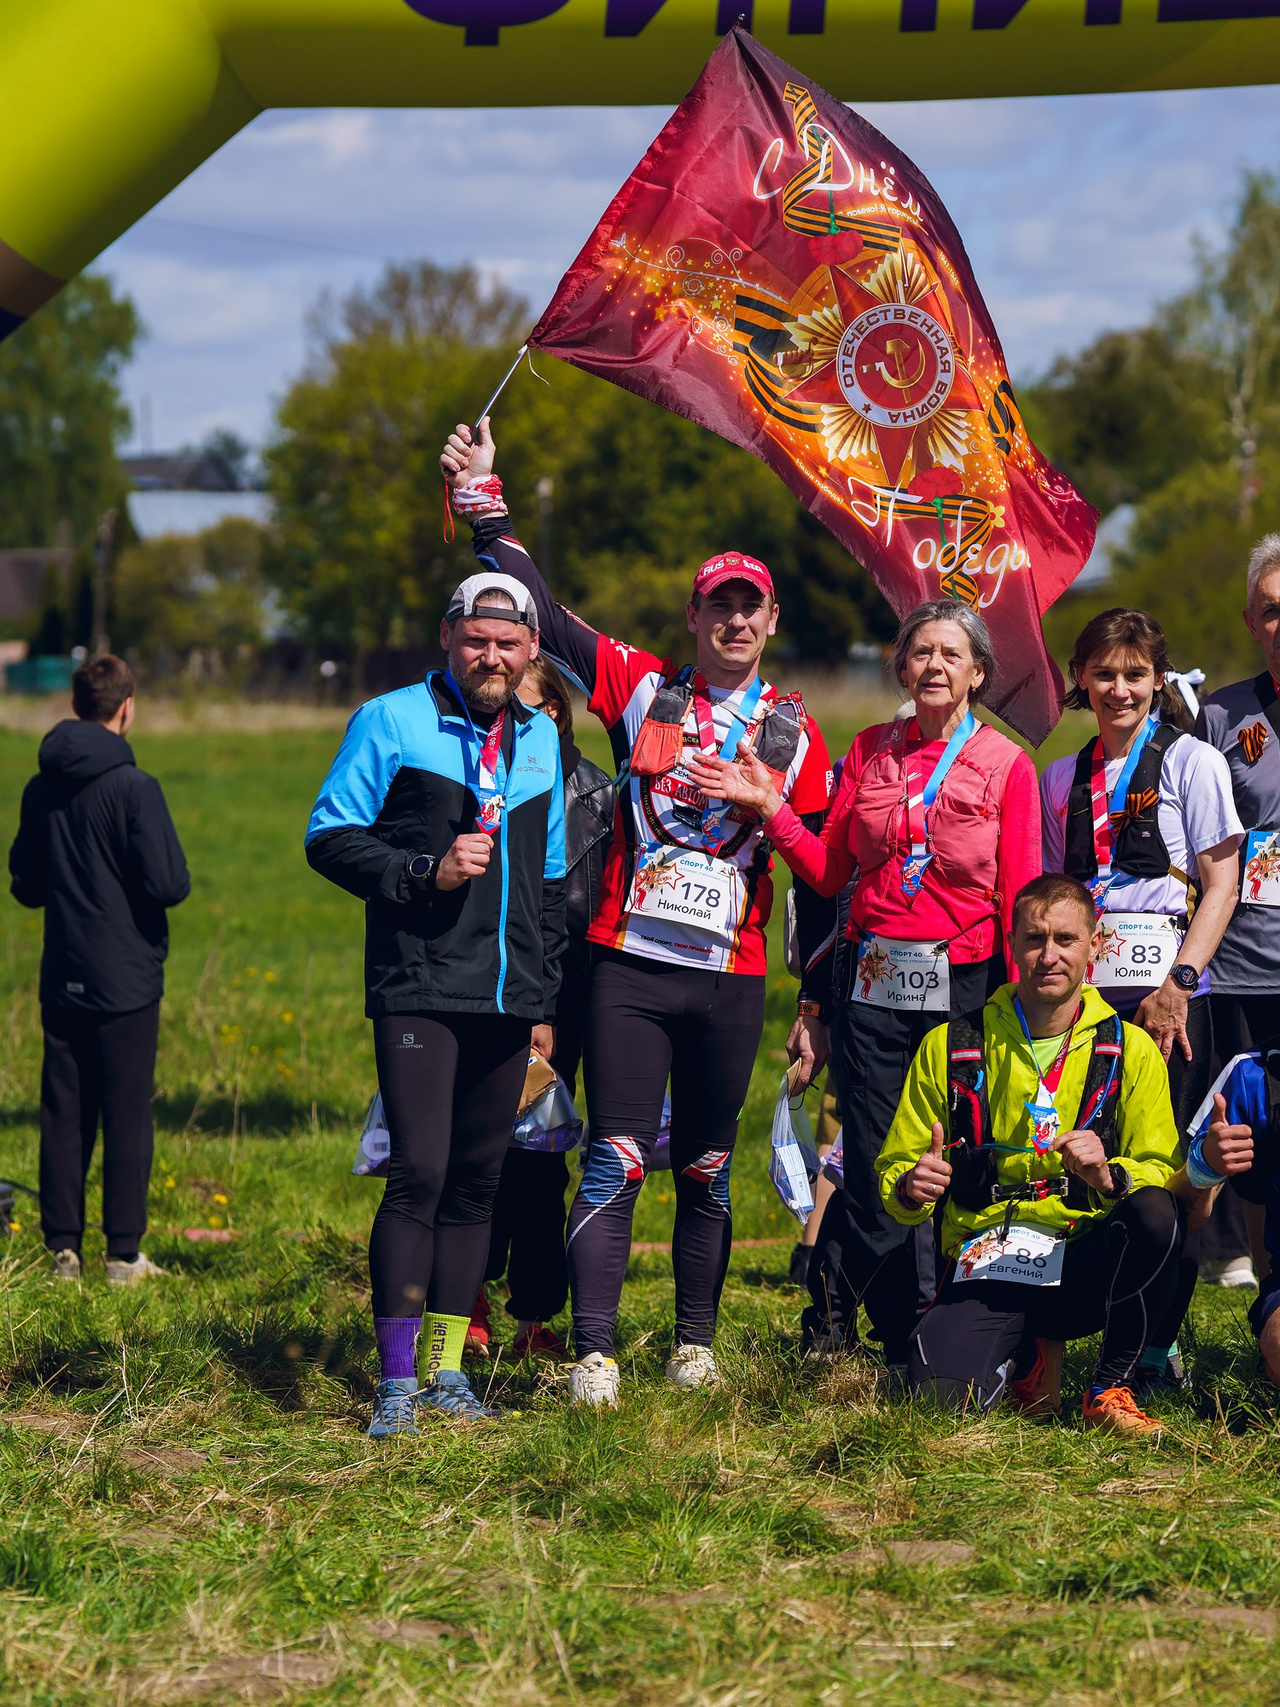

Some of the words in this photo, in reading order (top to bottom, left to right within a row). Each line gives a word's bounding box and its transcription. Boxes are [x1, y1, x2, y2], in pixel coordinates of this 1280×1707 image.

[842, 308, 951, 388] ОТЕЧЕСТВЕННАЯ
[703, 559, 724, 576] RUS
[680, 859, 704, 869] СПОРТ
[681, 882, 721, 908] 178
[657, 898, 712, 920] Николай
[1131, 945, 1162, 965] 83
[896, 971, 940, 989] 103
[1115, 967, 1152, 978] Юлия
[887, 990, 926, 1003] Ирина
[1015, 1247, 1047, 1268] 86
[988, 1263, 1043, 1279] Евгений
